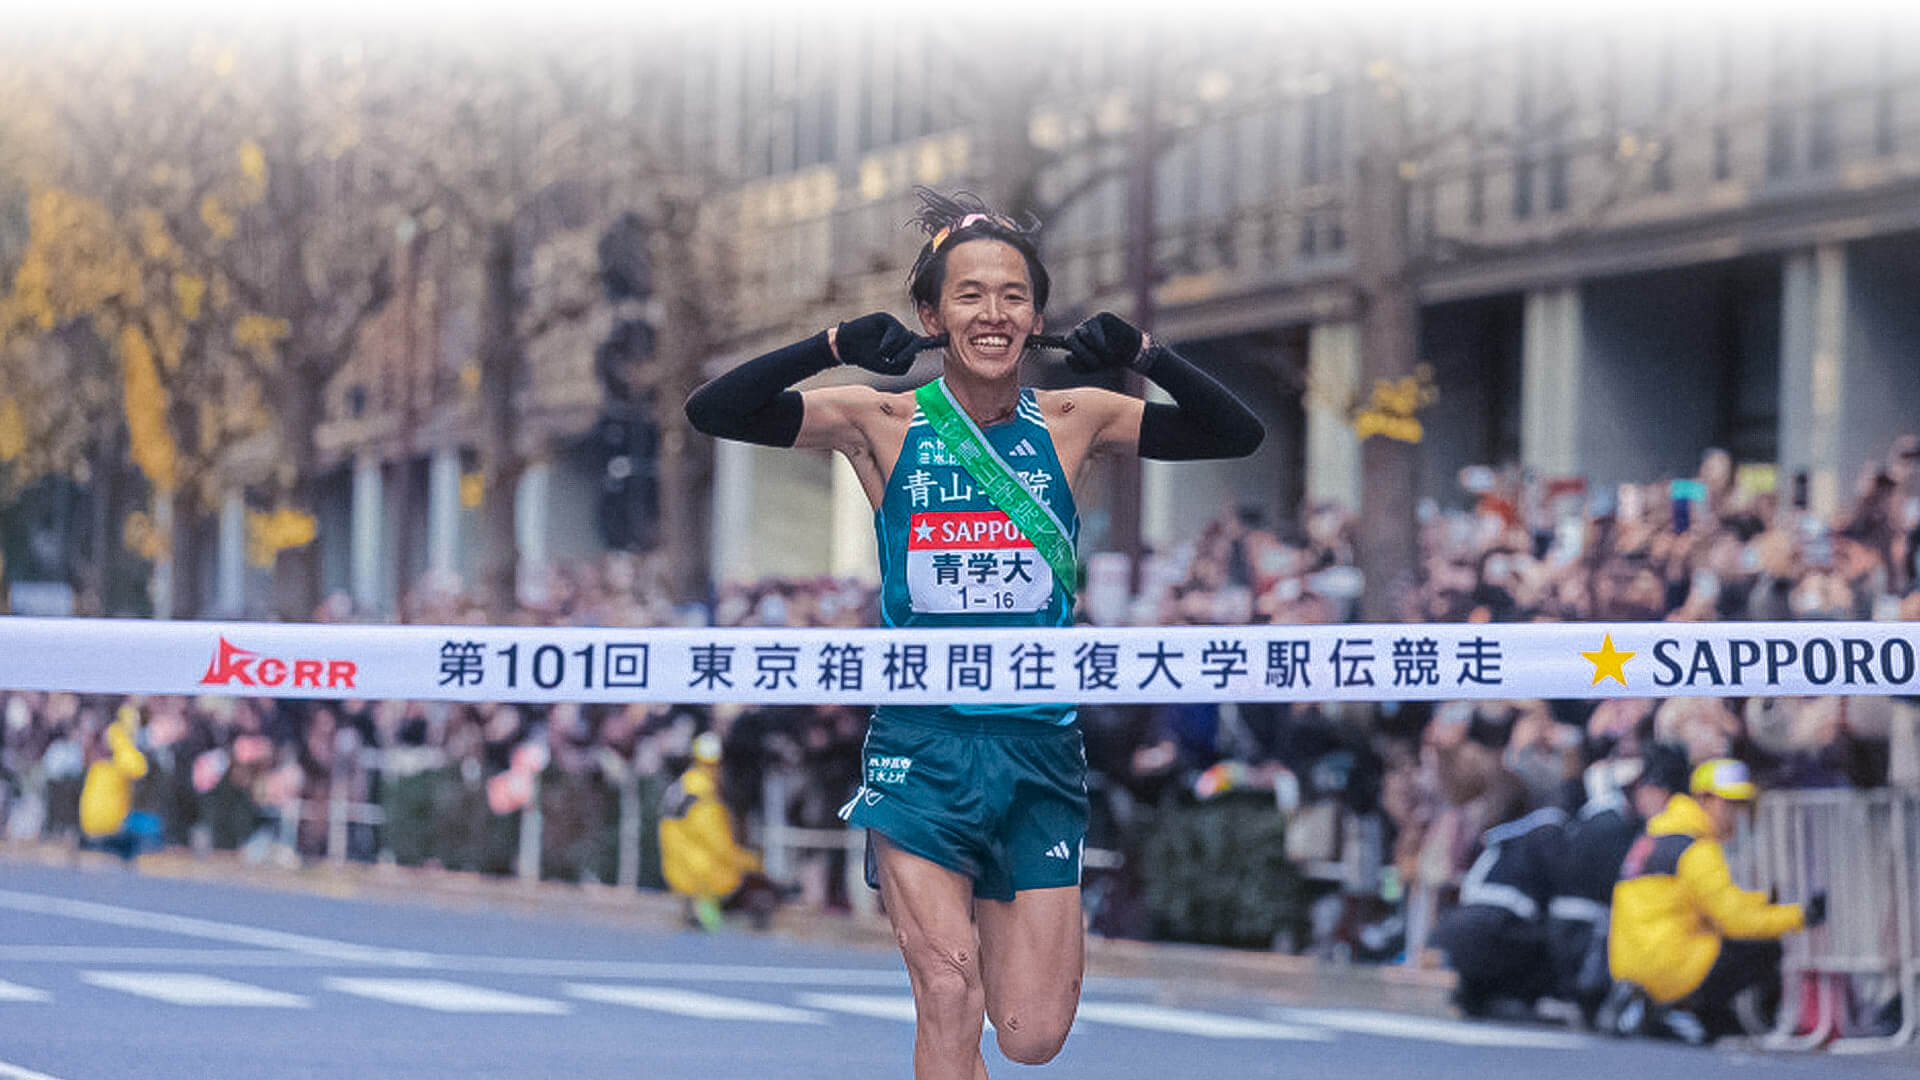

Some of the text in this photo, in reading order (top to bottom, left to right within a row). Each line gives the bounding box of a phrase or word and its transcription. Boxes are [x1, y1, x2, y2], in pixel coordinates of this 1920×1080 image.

[903, 468, 1053, 508] 青山院
[941, 520, 1028, 543] SAPPO
[931, 552, 1033, 586] 青学大
[438, 637, 1503, 691] 第101回 東京箱根間往復大学駅伝競走
[1652, 637, 1915, 687] SAPPORO
